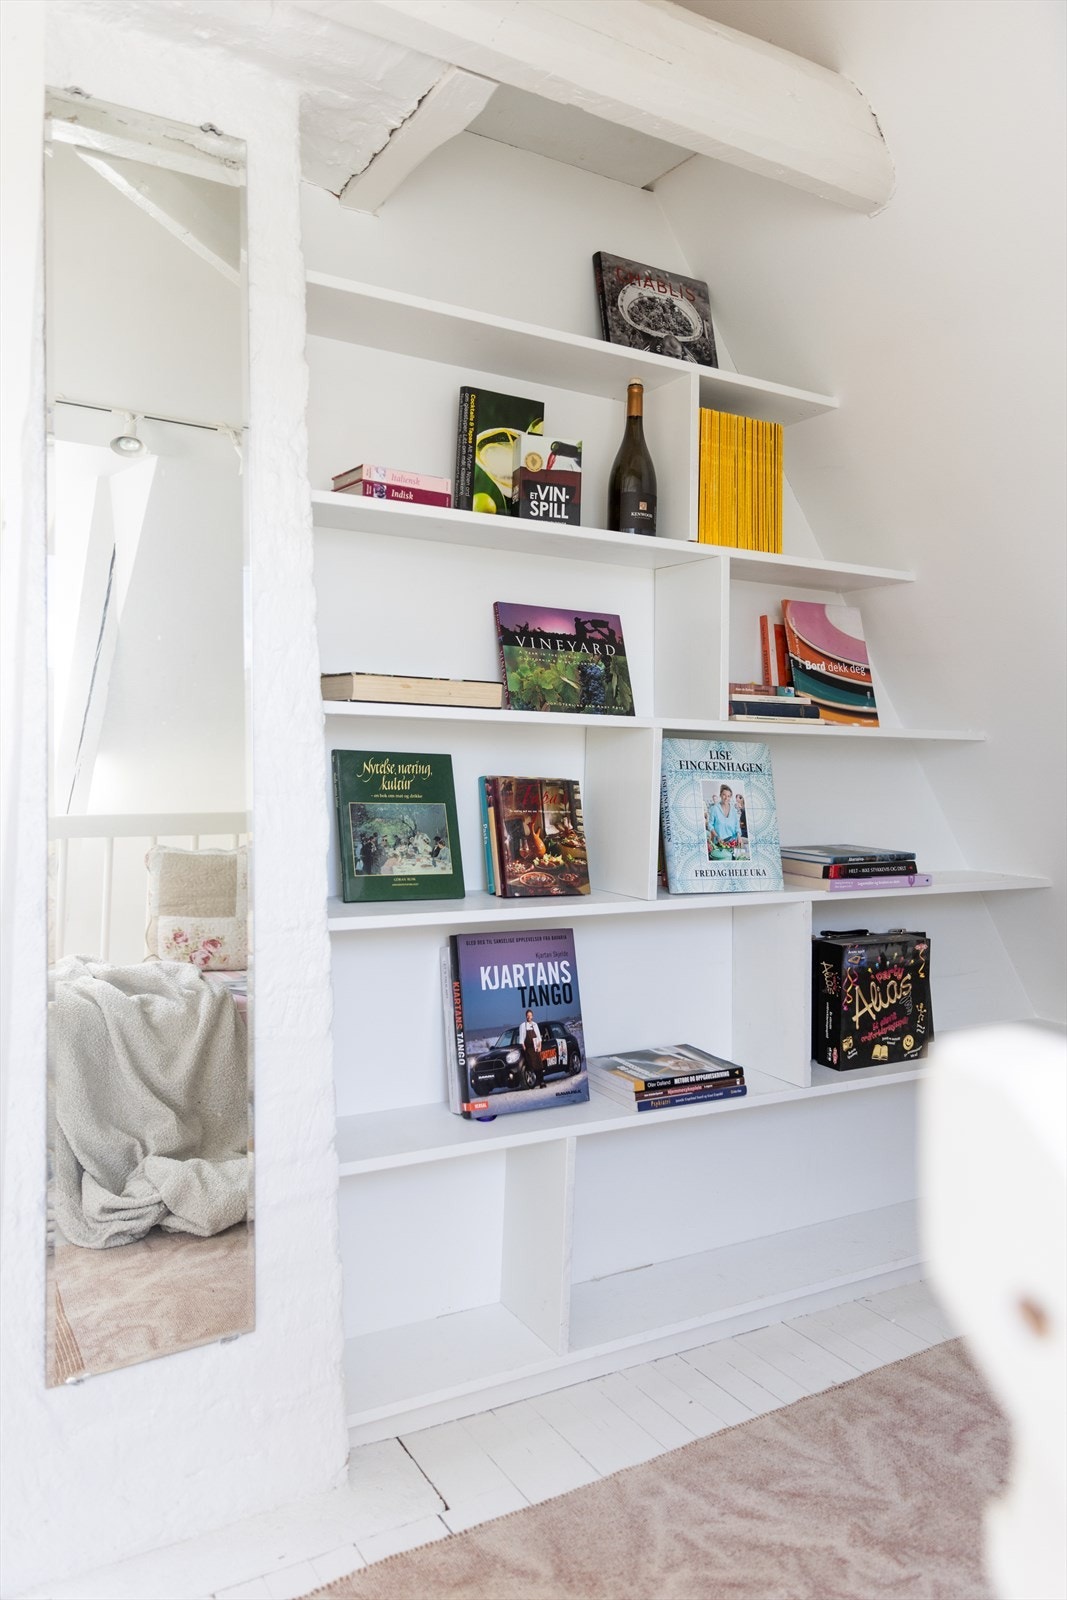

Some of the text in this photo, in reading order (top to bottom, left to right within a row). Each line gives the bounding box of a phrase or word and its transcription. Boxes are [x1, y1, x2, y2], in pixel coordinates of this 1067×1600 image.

[616, 267, 696, 302] CHABLIS
[392, 473, 420, 485] Italiensk
[392, 489, 414, 500] Indisk
[530, 492, 538, 500] ET
[536, 484, 570, 502] VIN-
[530, 500, 568, 519] SPILL
[515, 636, 616, 656] VINEYARD
[805, 660, 866, 676] Bord dekk deg
[709, 750, 732, 760] LISE
[356, 757, 432, 782] Nytelse, næring,
[679, 760, 763, 772] FINCKENHAGEN
[379, 774, 416, 791] kultur
[480, 960, 571, 990] KJARTANS
[820, 961, 835, 995] Alias
[518, 982, 573, 1008] TANGO
[852, 974, 912, 1030] Alias
[453, 982, 466, 1066] KJARTANS TANGO
[674, 1076, 689, 1084] METODE
[650, 1099, 670, 1107] Psykiatri
